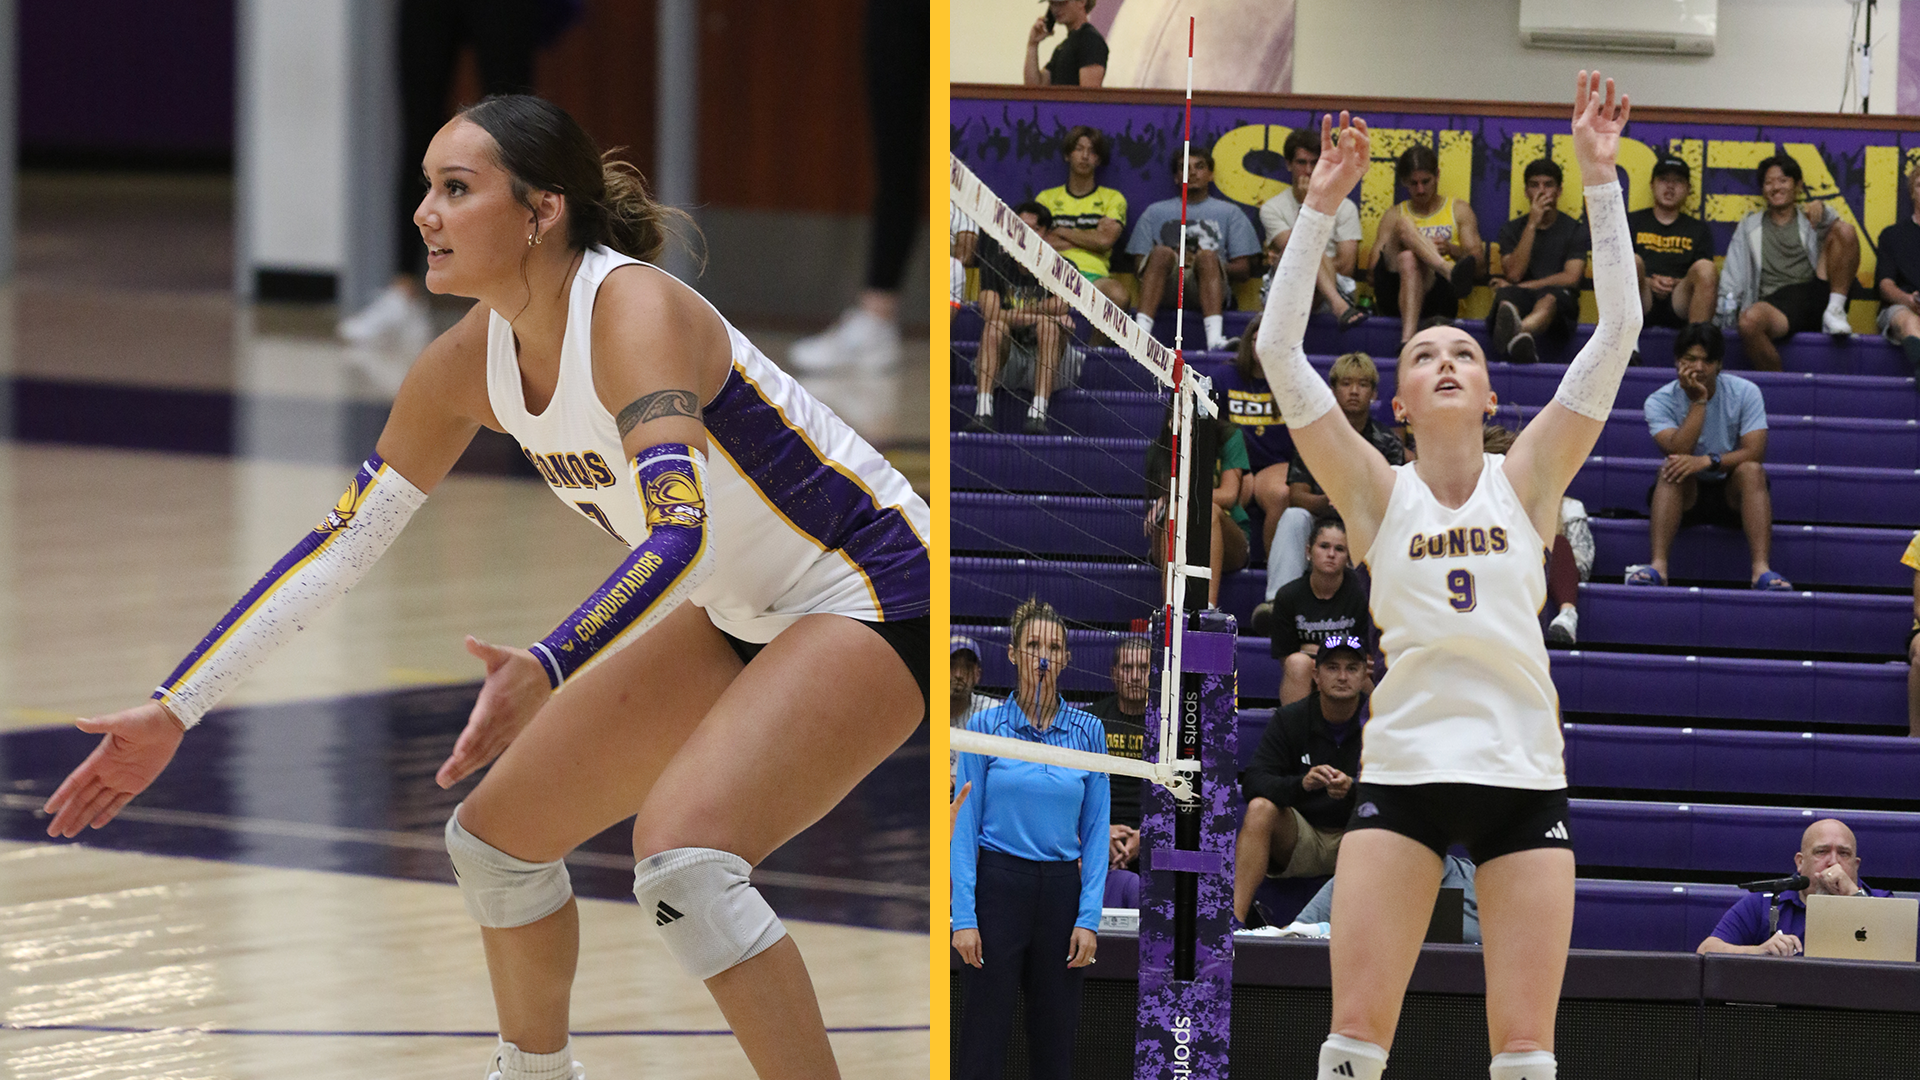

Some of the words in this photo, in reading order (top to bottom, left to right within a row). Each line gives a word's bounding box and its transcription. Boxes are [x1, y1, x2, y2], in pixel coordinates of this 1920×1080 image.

[1211, 124, 1920, 289] STUDEN
[573, 500, 631, 547] 7
[1409, 525, 1508, 560] CONQS
[575, 550, 663, 642] CONQUISTADORS
[1446, 567, 1477, 613] 9
[1183, 691, 1198, 744] sports
